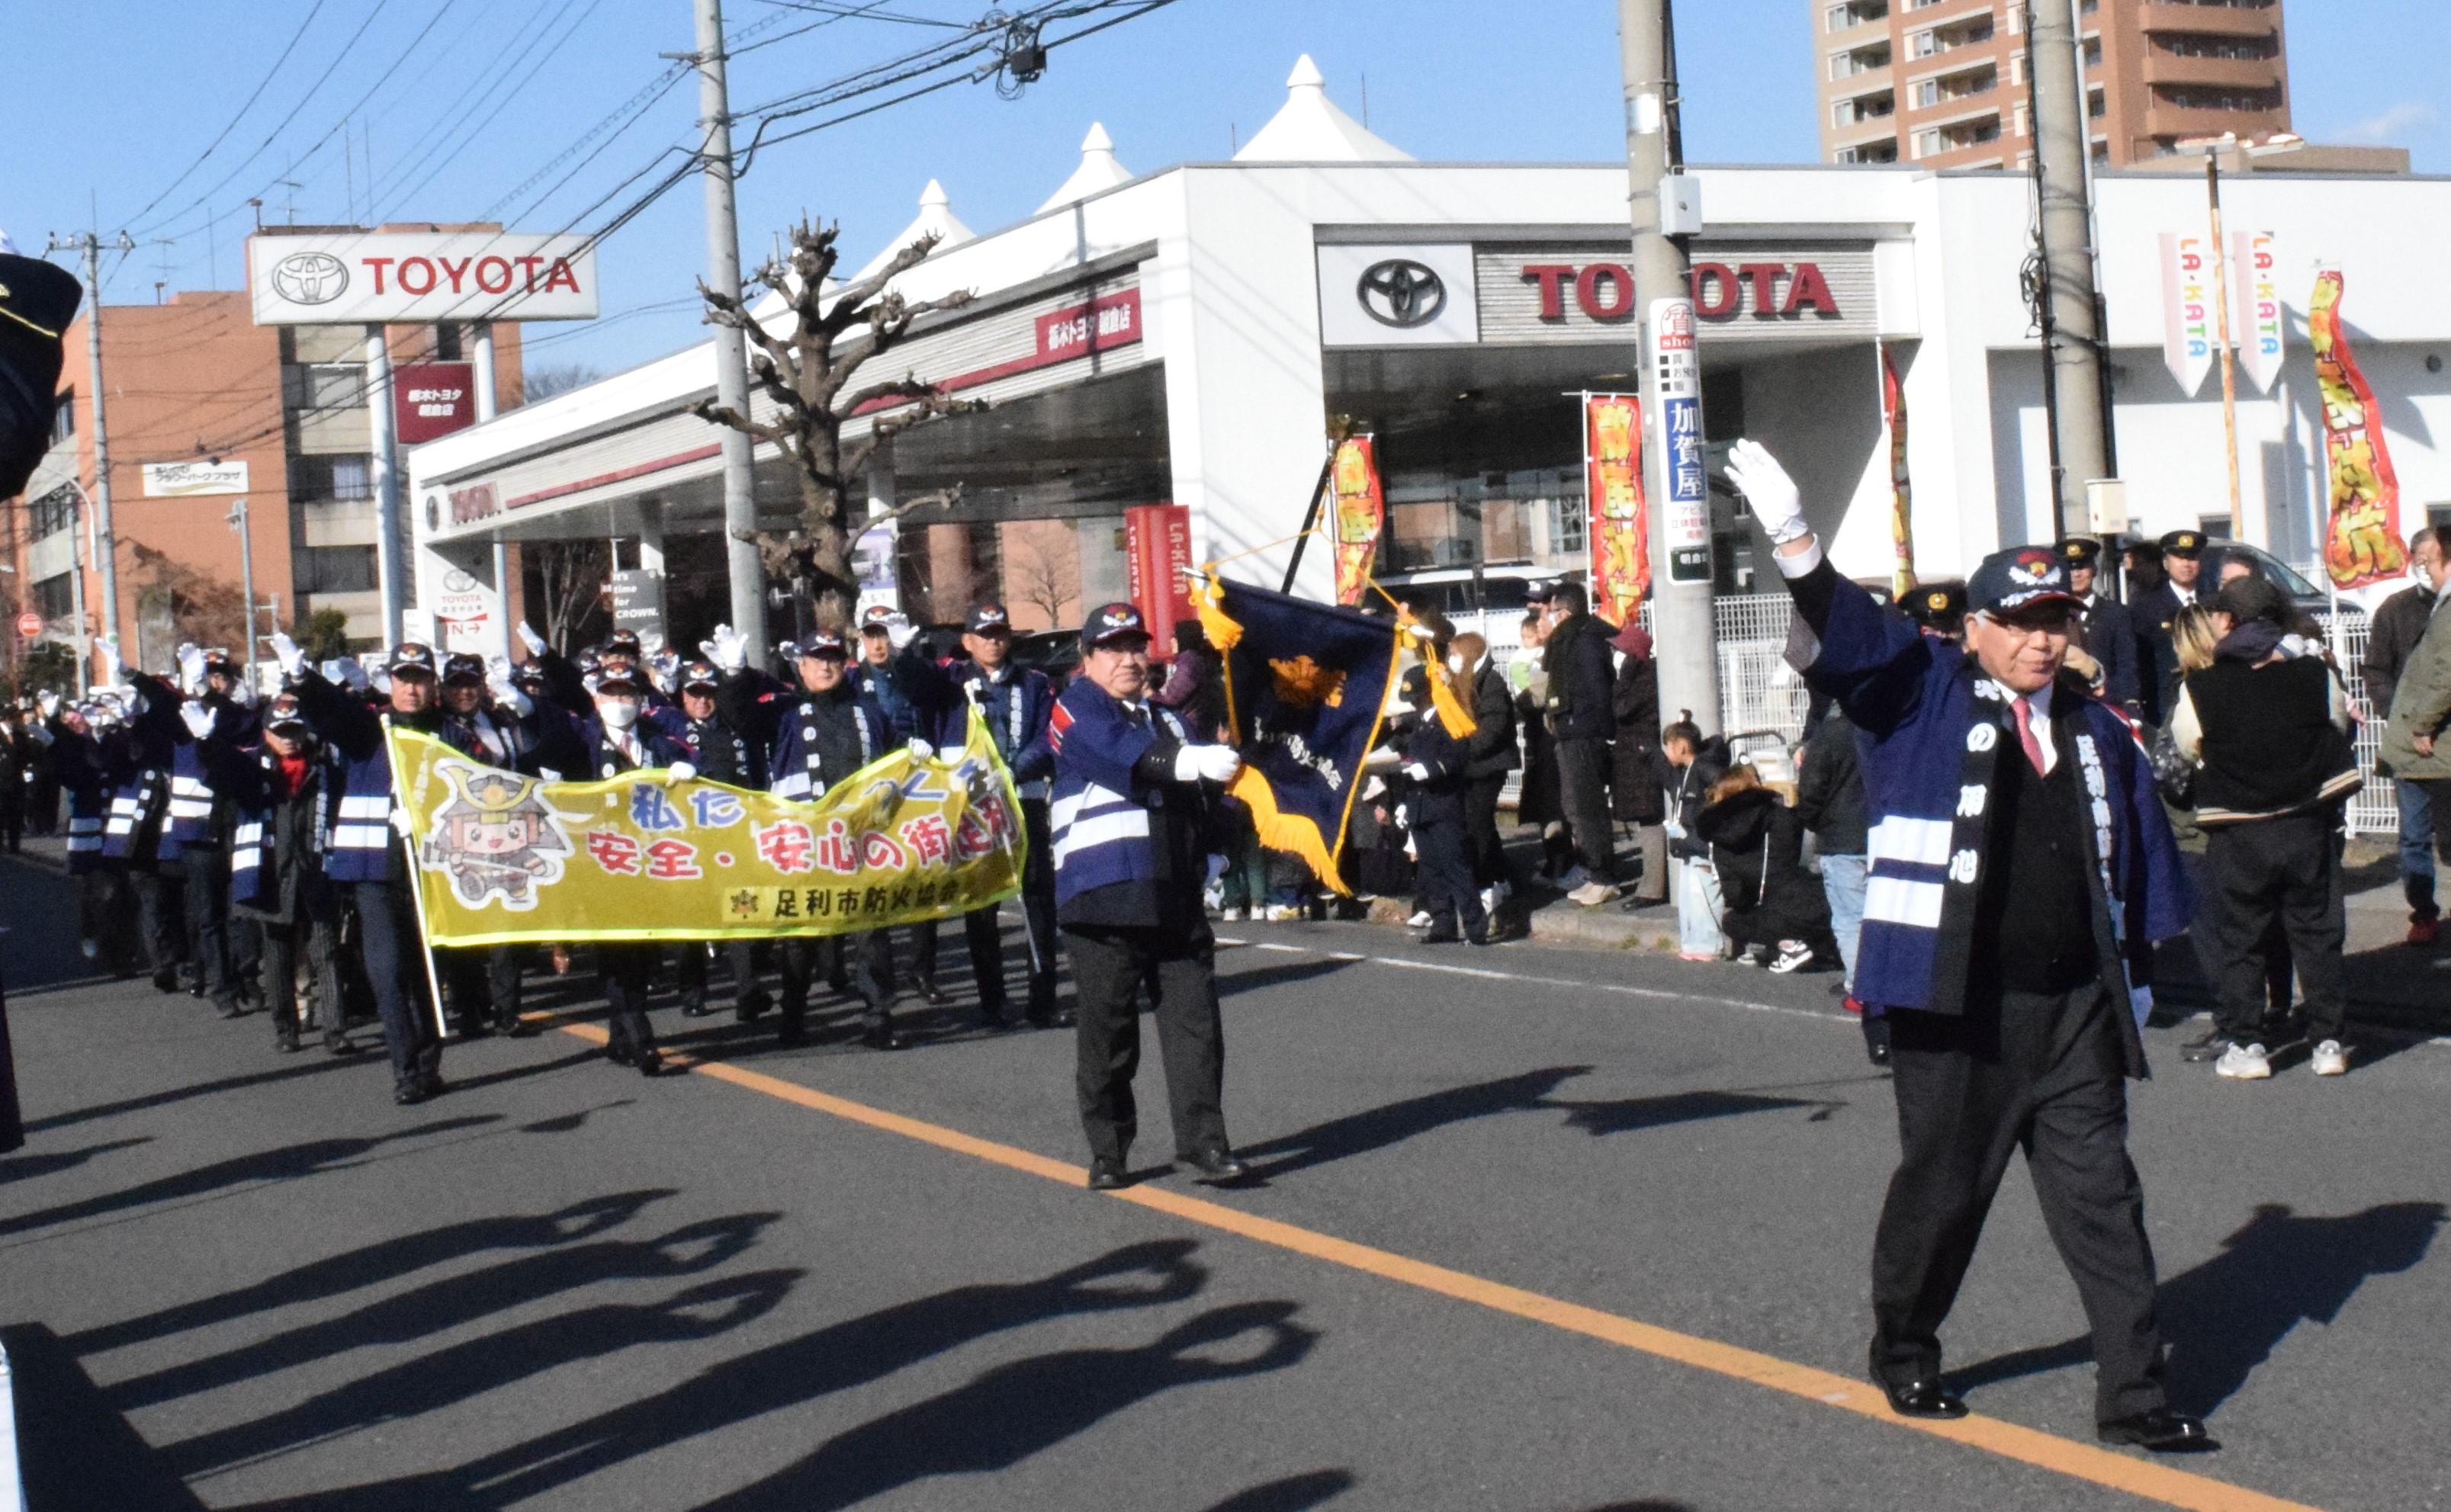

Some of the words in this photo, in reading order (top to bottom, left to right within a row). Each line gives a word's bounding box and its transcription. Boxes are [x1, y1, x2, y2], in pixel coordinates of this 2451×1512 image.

[361, 255, 581, 295] TOYOTA
[1521, 262, 1840, 319] TOOTA
[1662, 336, 1693, 348] sho
[1670, 403, 1703, 498] 加賀屋
